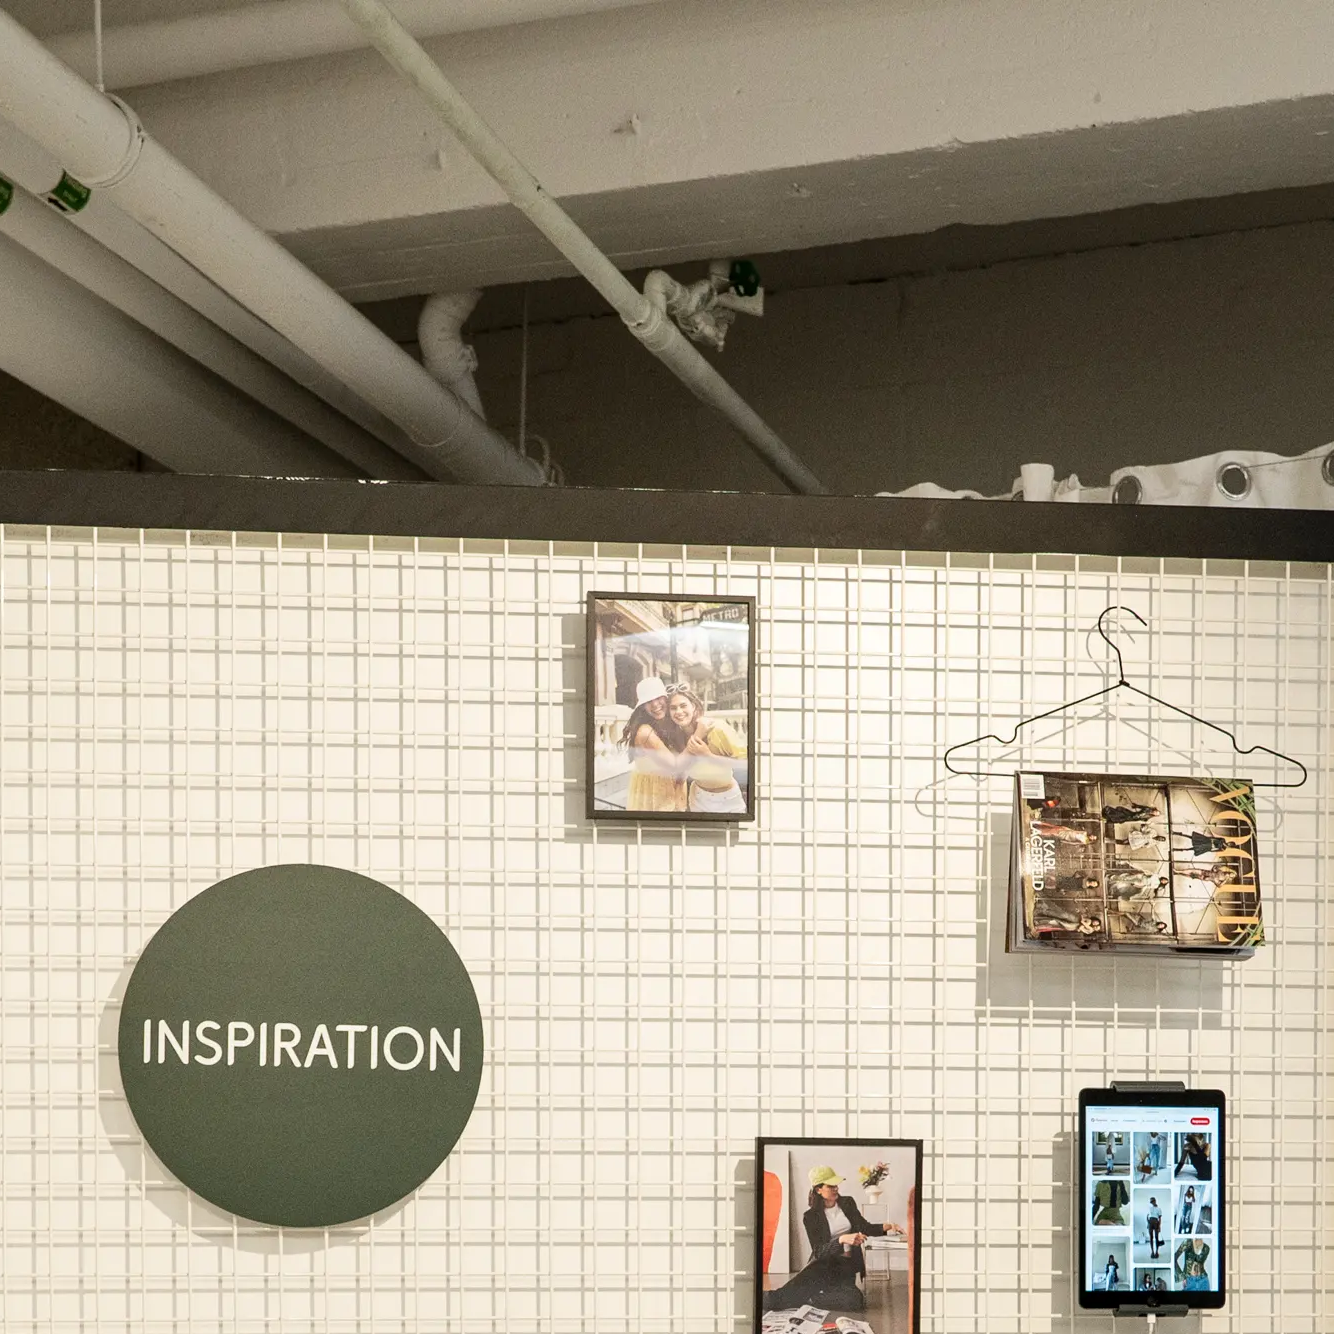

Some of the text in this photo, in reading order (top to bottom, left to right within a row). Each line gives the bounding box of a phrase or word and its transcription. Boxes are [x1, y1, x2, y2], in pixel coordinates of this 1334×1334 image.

[1029, 820, 1044, 891] LAGERFELD
[1043, 839, 1055, 873] KARL
[143, 1018, 461, 1072] INSPIRATION
